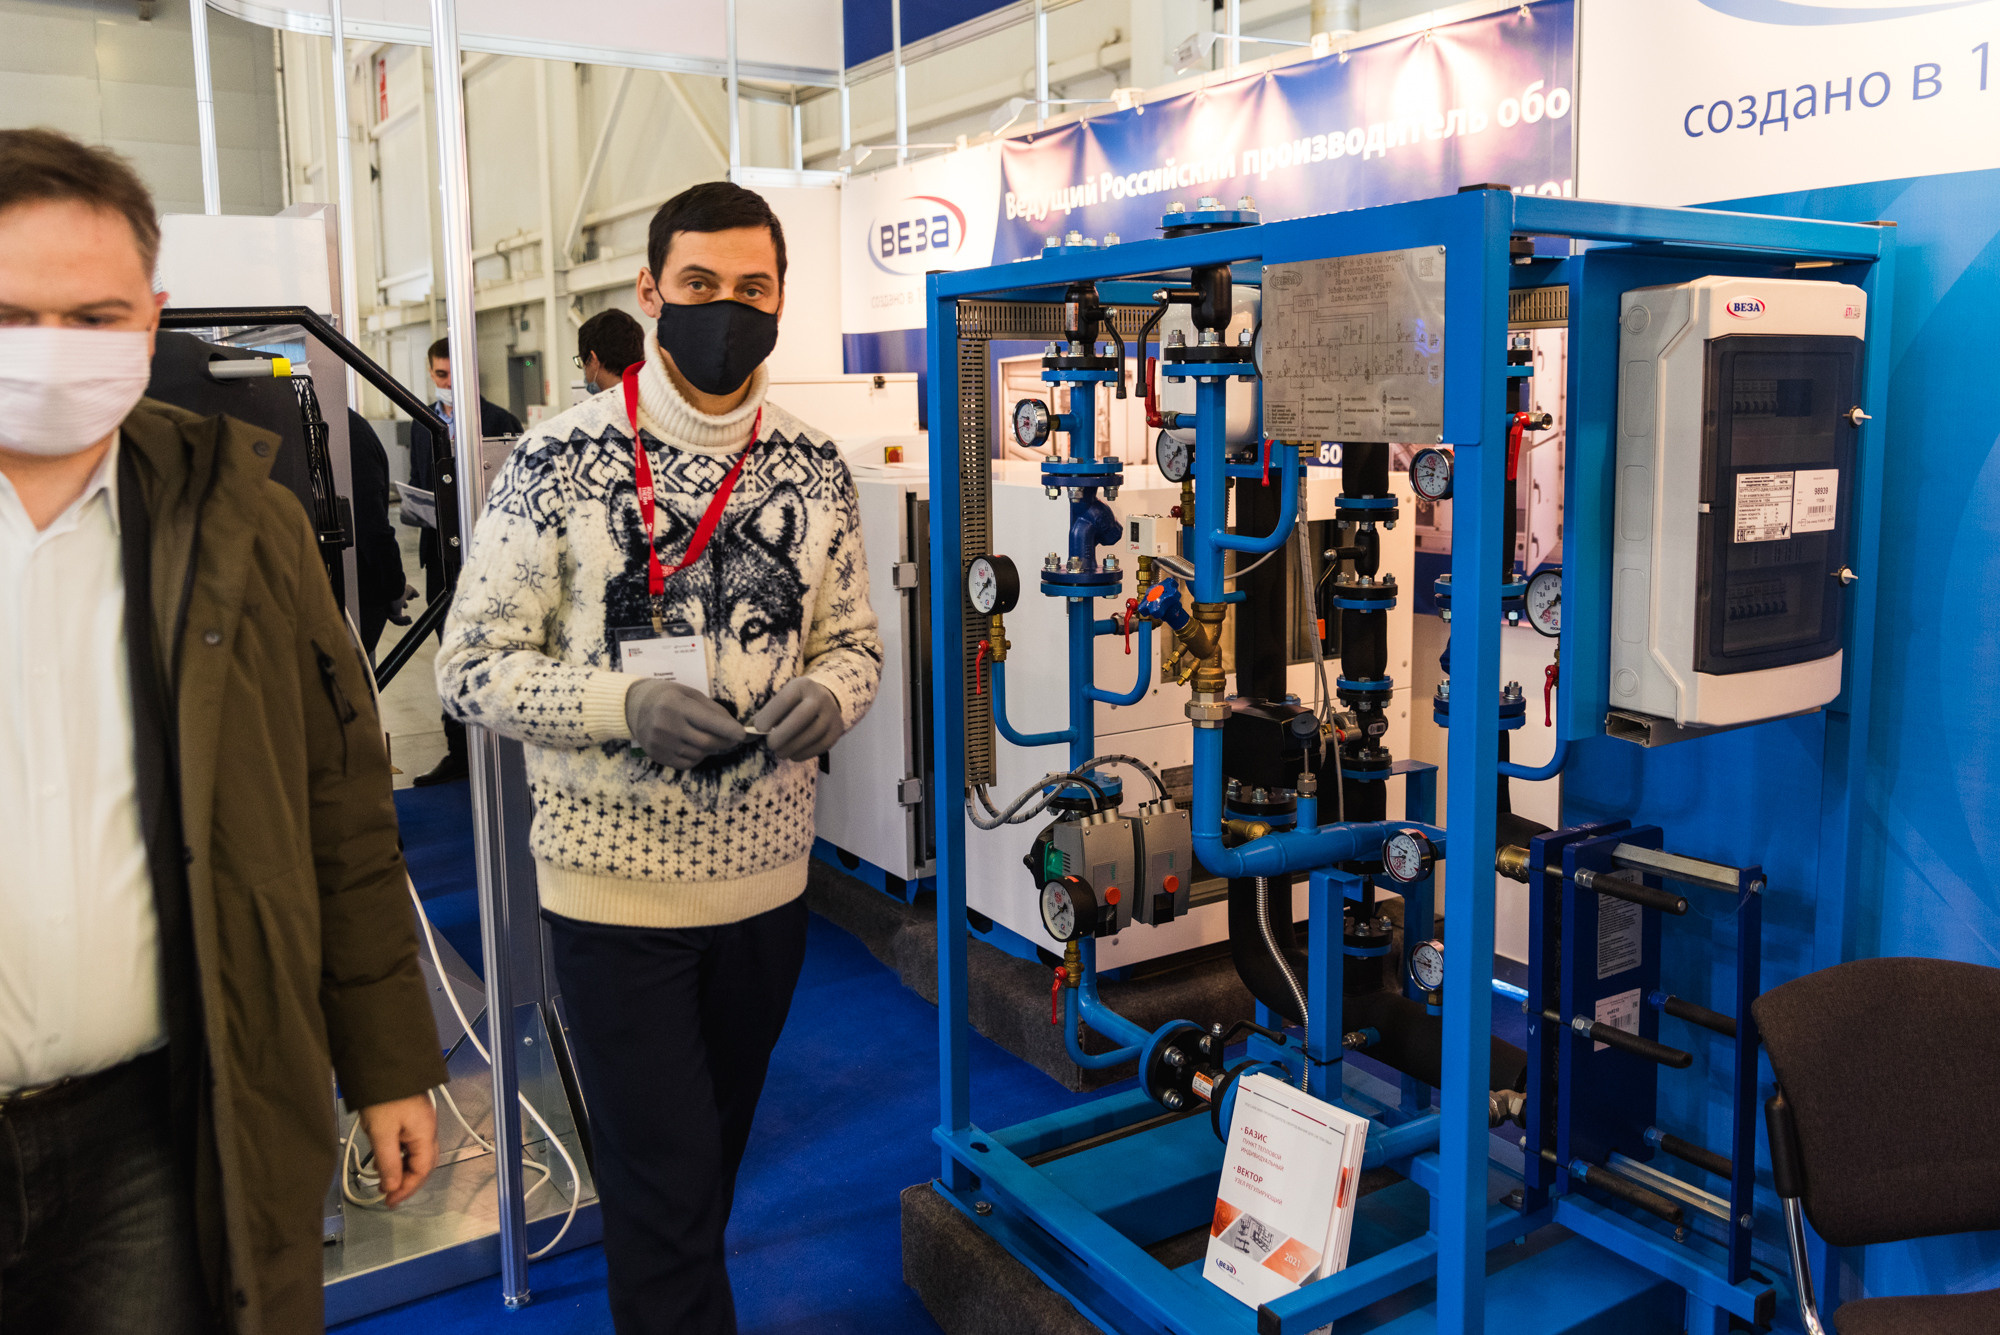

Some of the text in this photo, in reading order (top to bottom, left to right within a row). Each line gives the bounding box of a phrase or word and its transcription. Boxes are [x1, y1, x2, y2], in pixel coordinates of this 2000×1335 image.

[1683, 41, 1990, 138] создано в 1
[1005, 79, 1572, 222] Ведущий Российский производитель обо
[1733, 302, 1761, 312] ВЕЗА
[1243, 1125, 1268, 1144] БАЗИС
[1236, 1165, 1264, 1184] ВЕКТОР
[1284, 1253, 1300, 1268] 2021
